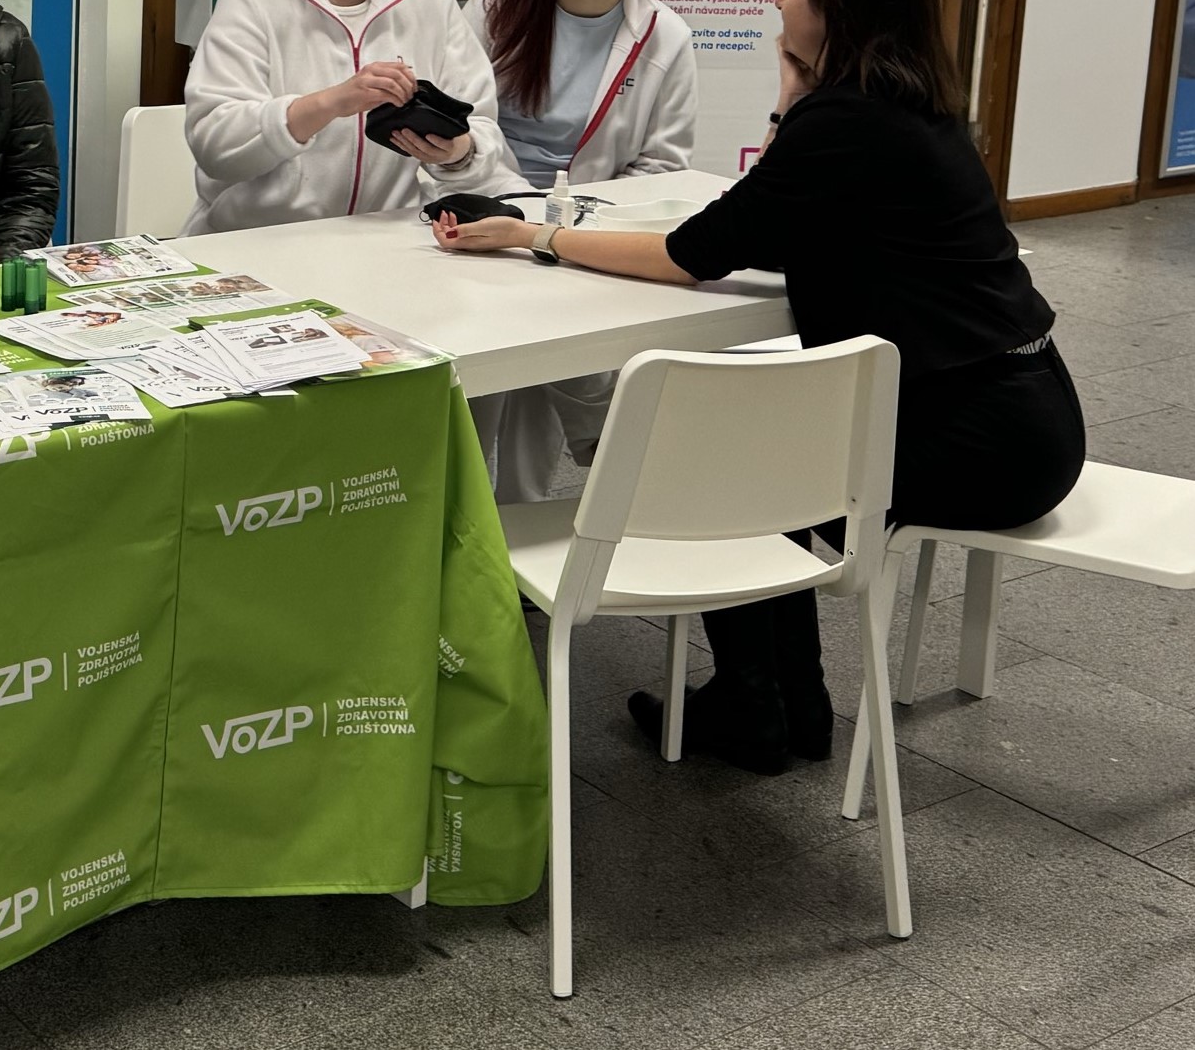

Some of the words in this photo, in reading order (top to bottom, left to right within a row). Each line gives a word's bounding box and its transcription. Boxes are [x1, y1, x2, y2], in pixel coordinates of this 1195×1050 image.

[695, 7, 737, 15] návazné
[739, 6, 764, 17] péče
[701, 42, 714, 50] na
[717, 29, 731, 38] od
[733, 29, 763, 39] svého
[80, 423, 155, 448] POJIŠŤOVNA
[342, 466, 397, 488] VOJENSKÁ
[343, 478, 399, 502] ZDRAVOTNÍ
[215, 486, 323, 536] VoZP
[341, 493, 407, 514] POJIŠŤOVNA
[77, 630, 140, 658] VOJENSKÁ
[78, 643, 140, 673] ZDRAVOTNÍ
[78, 654, 143, 687] POJIŠŤOVNA
[336, 695, 406, 709] VOJENSKÁ
[337, 708, 409, 723] ZDRAVOTNÍ
[200, 705, 314, 759] VoZP
[336, 722, 416, 735] POJIŠŤOVNA
[61, 849, 125, 882] VOJENSKÁ
[62, 861, 126, 897] ZDRAVOTNÍ
[63, 874, 131, 911] POJIŠŤOVNA
